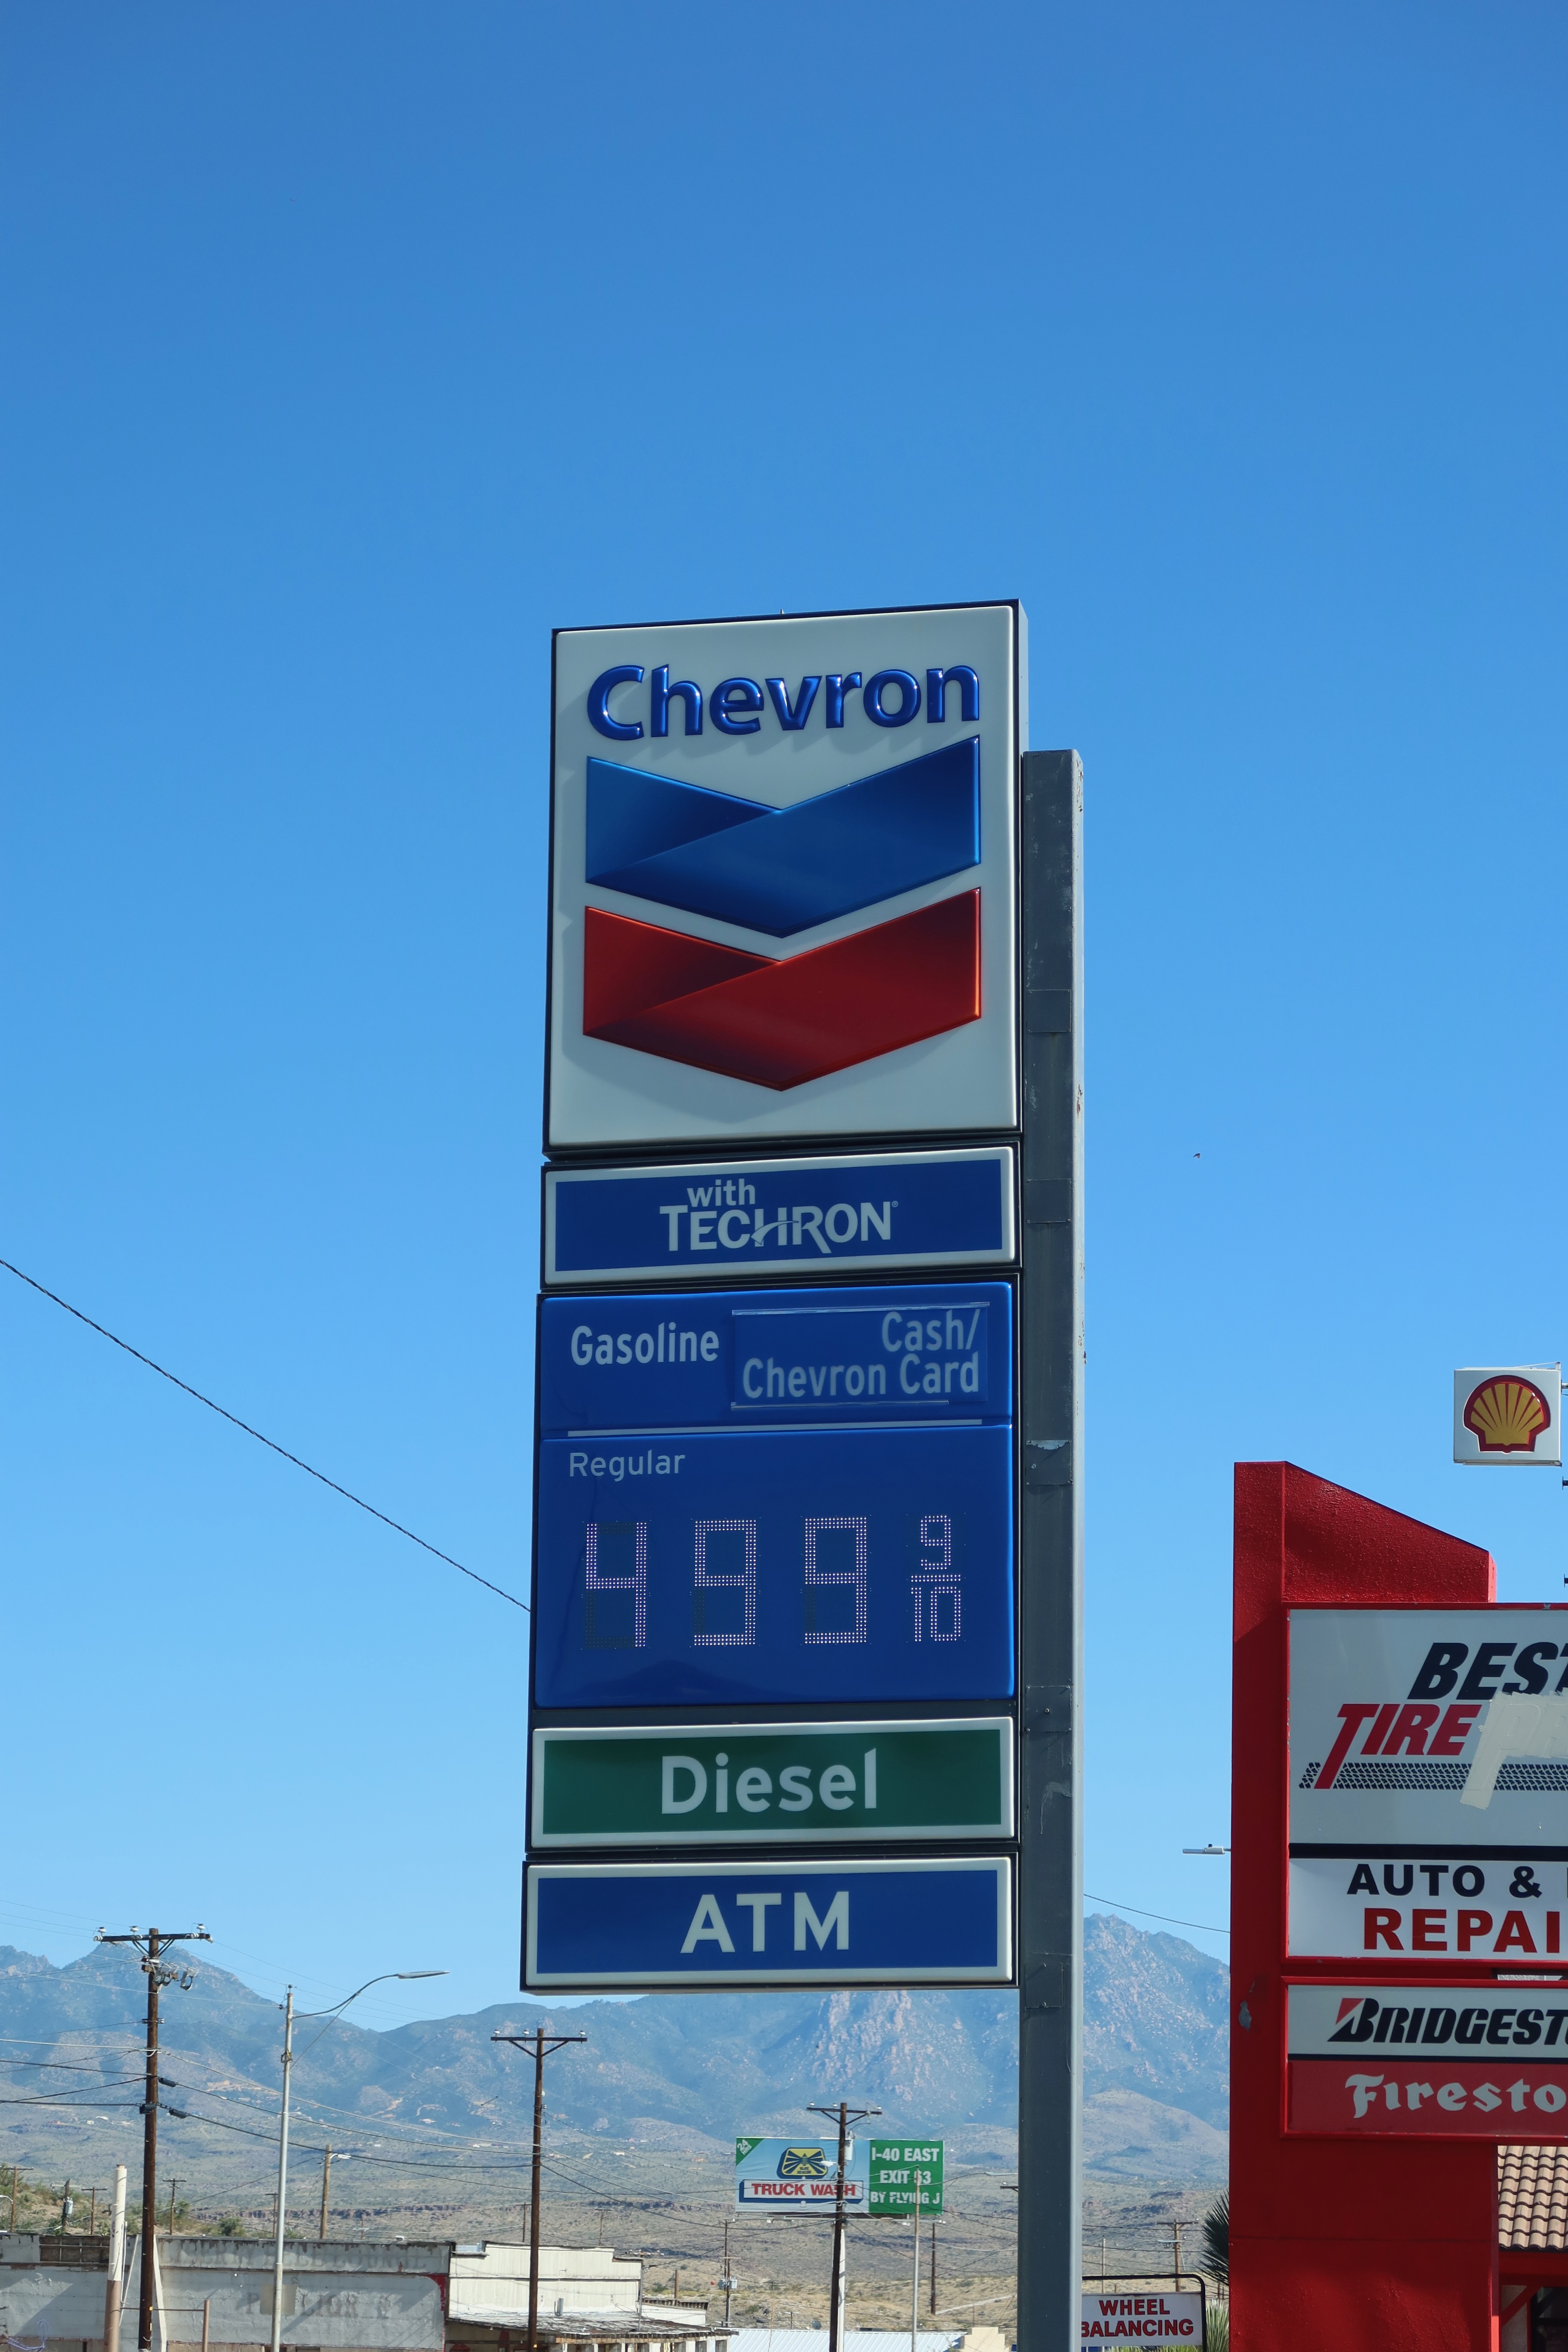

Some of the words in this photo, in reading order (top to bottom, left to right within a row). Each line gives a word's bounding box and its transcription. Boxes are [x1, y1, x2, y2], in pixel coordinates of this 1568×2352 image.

[586, 664, 980, 741] Chevron
[687, 1178, 755, 1207] with
[571, 1322, 720, 1366] Gasoline
[882, 1309, 980, 1353] Cash/
[742, 1358, 887, 1399] Chevron
[900, 1354, 980, 1395] Card
[569, 1449, 686, 1482] Regular
[1314, 1703, 1482, 1789] TIRE
[662, 1748, 877, 1814] Diesel
[1347, 1864, 1485, 1897] AUTO
[1509, 1866, 1542, 1898] &
[680, 1891, 849, 1954] ATM
[1364, 1908, 1560, 1953] REPAI
[1327, 1998, 1568, 2045] BRIDGEST
[737, 2139, 748, 2151] 24
[741, 2144, 752, 2156] HRS
[871, 2147, 900, 2161] I-40
[904, 2148, 940, 2162] EAST
[751, 2183, 805, 2196] TRUCK
[880, 2170, 910, 2184] EXIT
[870, 2191, 886, 2203] BY
[932, 2193, 940, 2205] J
[1099, 2299, 1170, 2316] WHEEL
